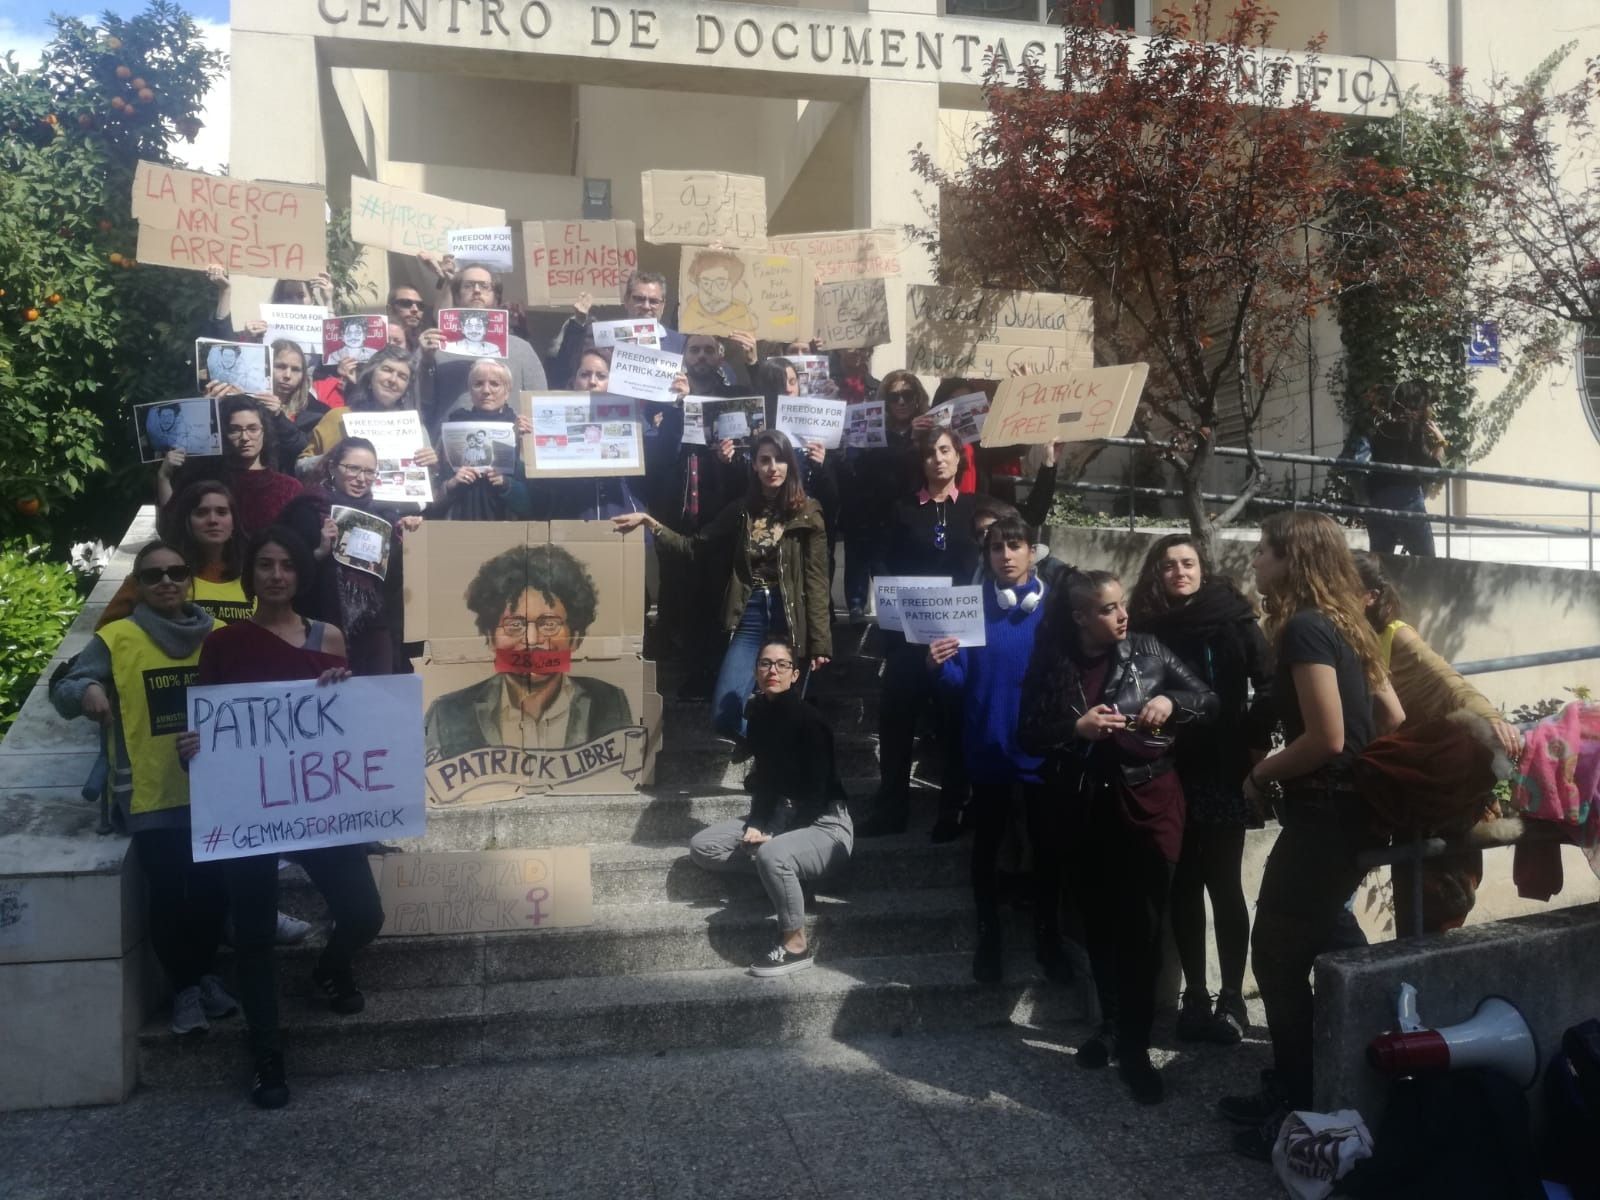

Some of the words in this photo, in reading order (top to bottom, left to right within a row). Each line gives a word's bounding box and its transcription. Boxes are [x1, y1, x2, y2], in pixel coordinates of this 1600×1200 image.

[318, 0, 552, 40] CENTRO
[590, 6, 660, 50] DE
[696, 14, 1125, 88] DOCUMENTACI
[146, 169, 177, 203] LA
[191, 178, 299, 218] RICERCA
[451, 234, 491, 242] FREEDOM
[564, 224, 591, 245] EL
[170, 235, 305, 272] ARRESTA
[452, 244, 488, 252] PATRICK
[533, 245, 637, 267] FEMINISMO
[616, 362, 652, 376] PATRICK
[617, 351, 659, 365] FREEDOM
[660, 359, 678, 368] FOR
[984, 357, 993, 378] y
[1016, 379, 1102, 406] PATRICK
[781, 404, 823, 414] FREEDOM
[825, 408, 842, 416] FOR
[782, 415, 819, 426] PATRICK
[821, 419, 840, 427] ZAKI
[1001, 412, 1051, 439] FREE
[902, 598, 953, 607] FREEDOM
[956, 596, 978, 605] FOR
[905, 611, 949, 620] PATRICK
[952, 610, 978, 619] ZAKI
[511, 653, 533, 669] 28
[148, 674, 181, 690] 100%
[194, 693, 345, 752] PATRICK
[438, 749, 556, 792] PATRICK
[560, 737, 622, 779] LIBRE
[260, 750, 395, 809] LIBRE
[396, 857, 548, 888] LIBERTAD
[394, 899, 519, 932] PATRICK
